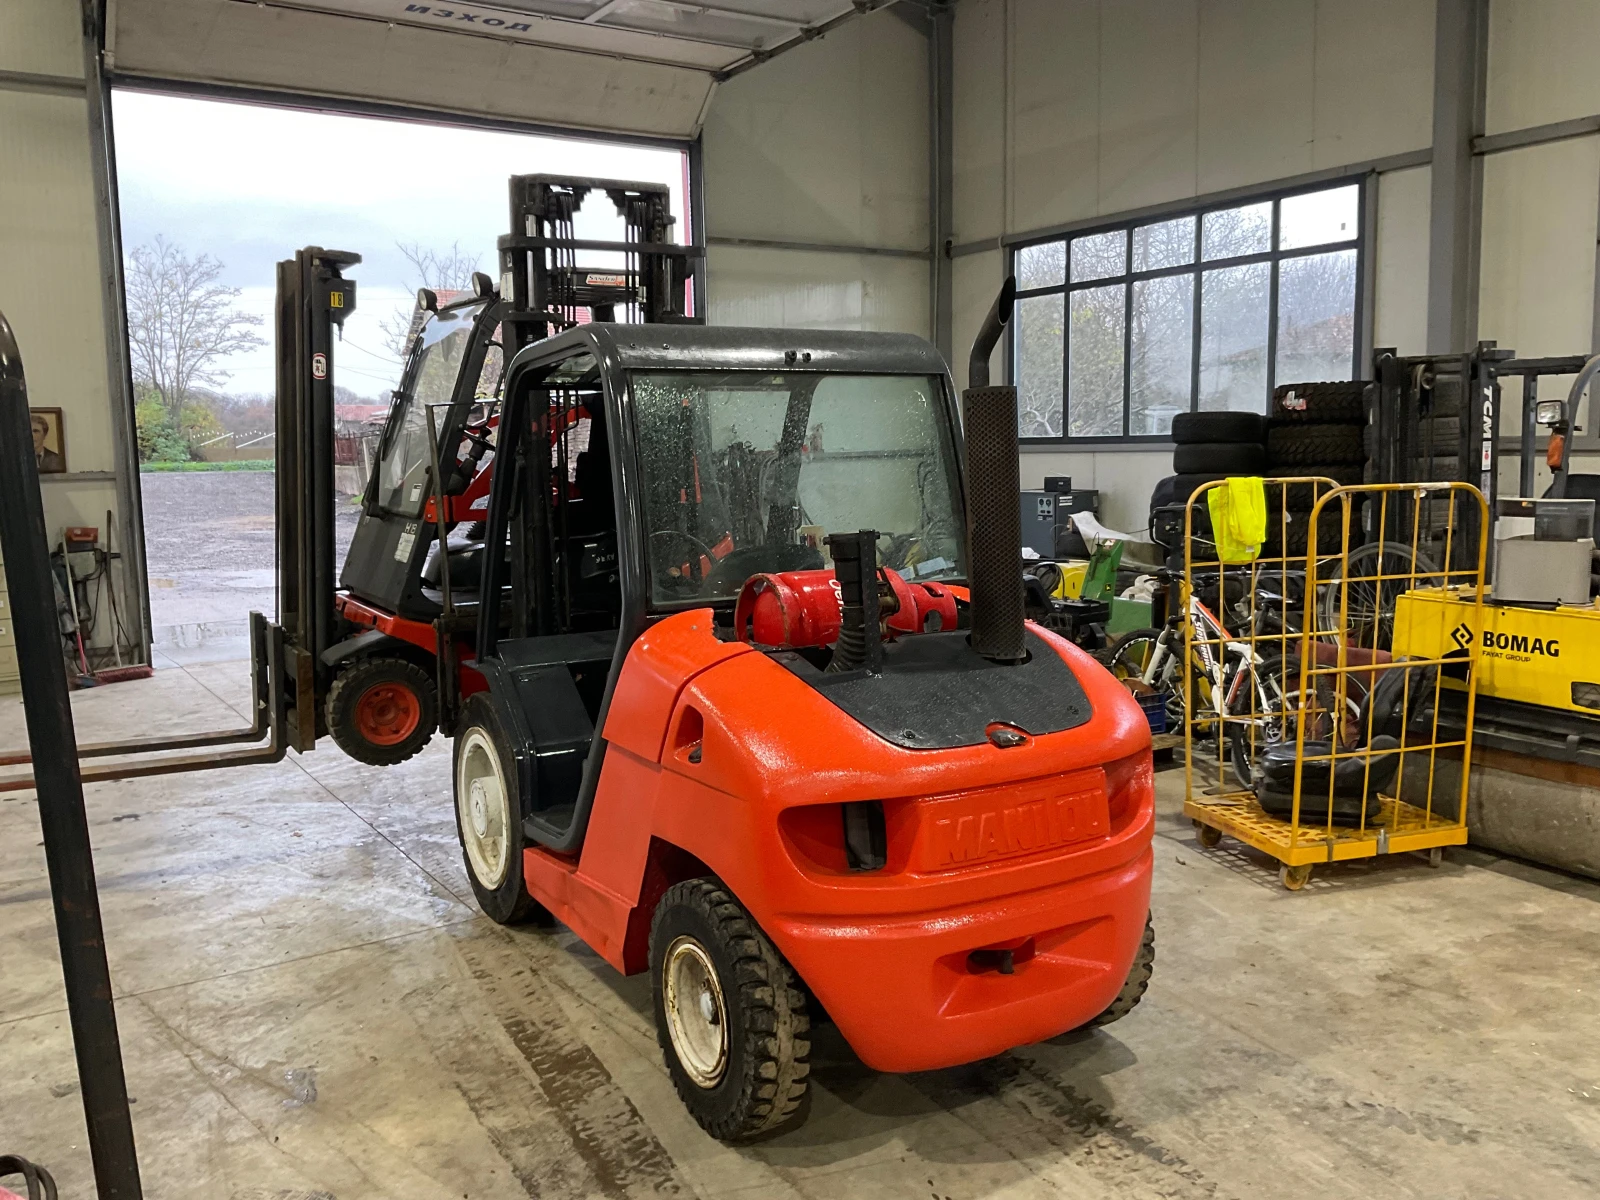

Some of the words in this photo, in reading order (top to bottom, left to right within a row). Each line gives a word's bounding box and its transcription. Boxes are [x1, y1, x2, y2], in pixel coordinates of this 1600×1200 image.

[405, 4, 532, 32] ИЗХОД
[332, 293, 343, 307] 18
[1483, 385, 1493, 438] TCM
[1482, 650, 1503, 658] FAYAT
[1505, 653, 1531, 662] GROUP
[1483, 631, 1560, 657] BOMAG
